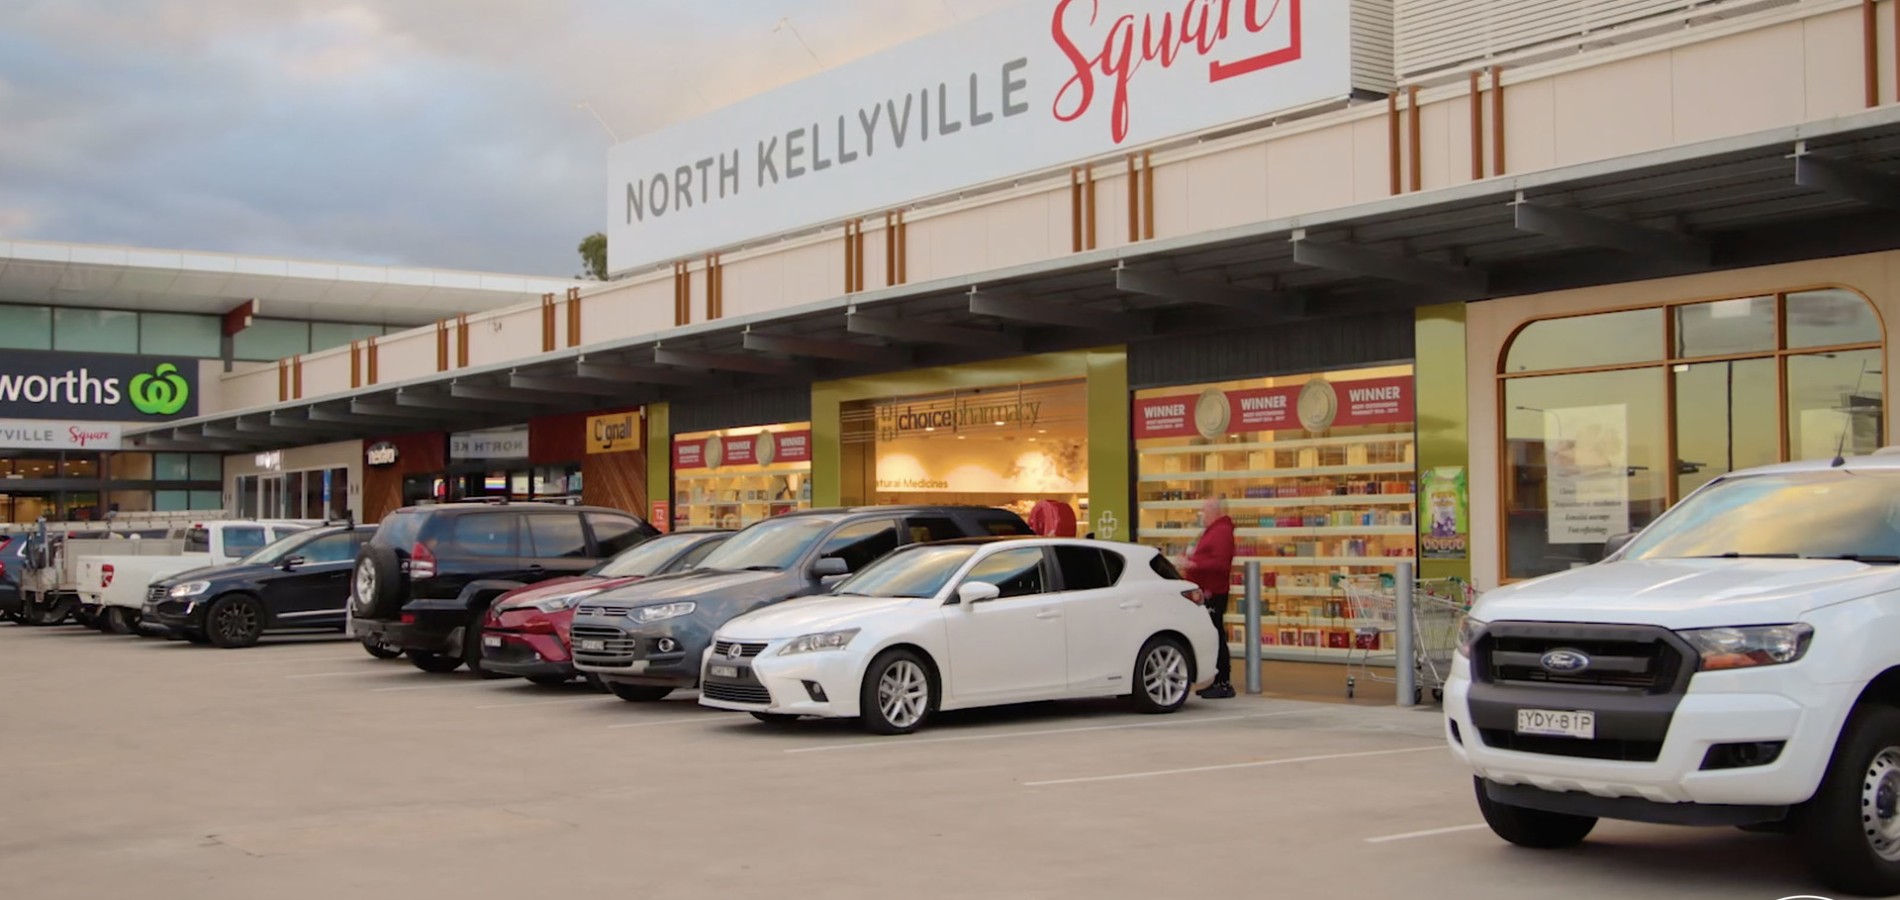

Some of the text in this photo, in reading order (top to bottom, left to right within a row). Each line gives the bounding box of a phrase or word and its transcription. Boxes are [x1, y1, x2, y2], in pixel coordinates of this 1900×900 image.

[626, 148, 739, 225] NORTH
[758, 57, 1029, 188] KELLYVILLE
[0, 368, 121, 405] worths
[1349, 385, 1400, 402] WINNER
[1241, 395, 1287, 410] WINNER
[1144, 404, 1185, 418] WINNER
[903, 478, 948, 489] Medicines
